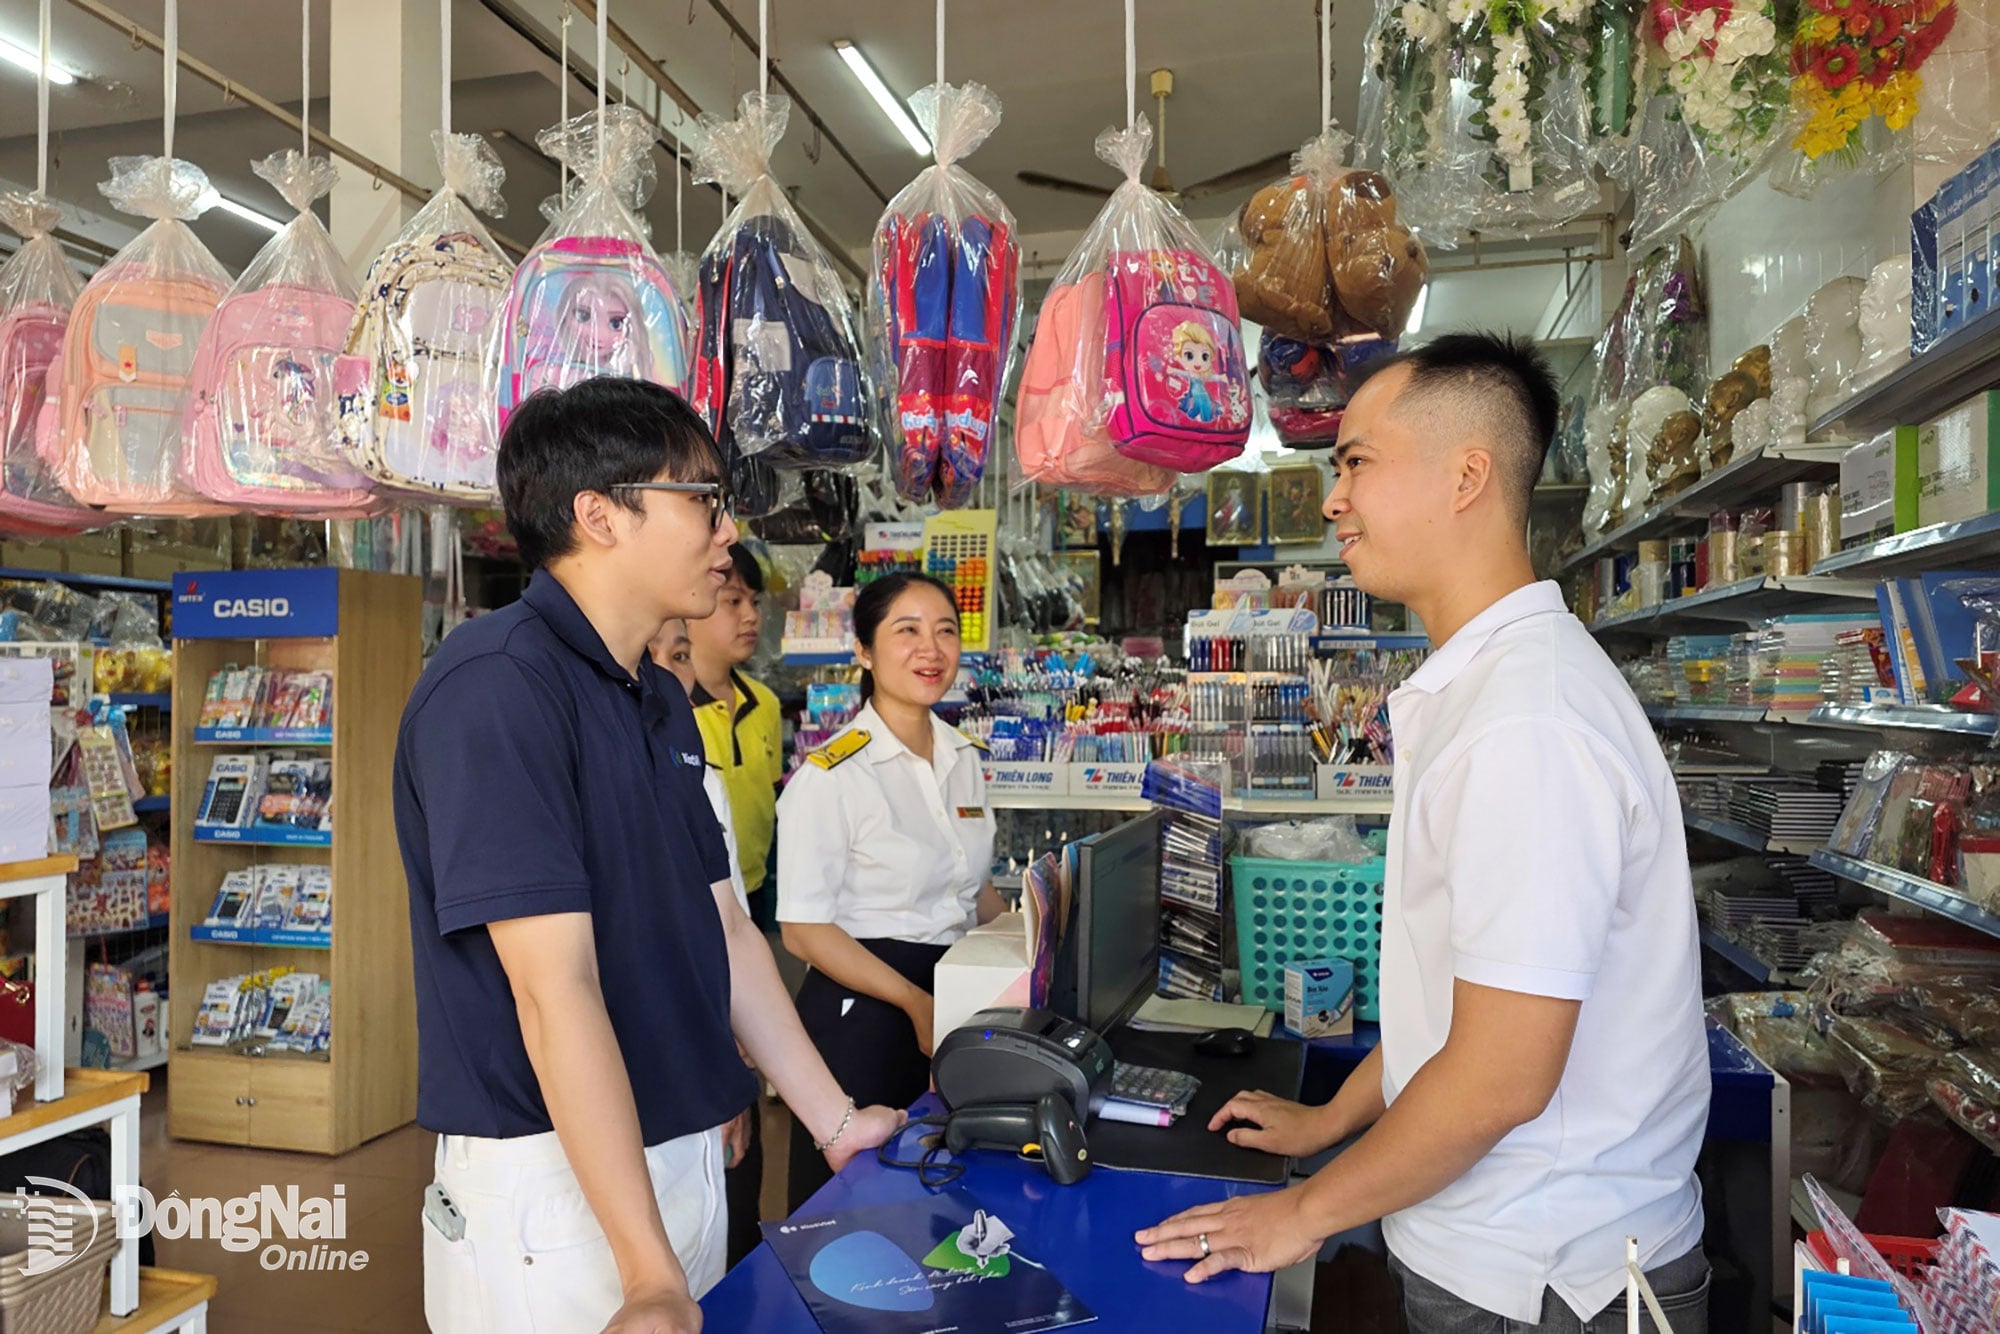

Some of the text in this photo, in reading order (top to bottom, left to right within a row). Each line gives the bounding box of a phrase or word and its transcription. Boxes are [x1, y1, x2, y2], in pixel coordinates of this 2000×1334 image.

[213, 598, 289, 618] CASIO
[215, 730, 241, 739] CASIO
[216, 763, 247, 773] CASIO
[996, 769, 1053, 783] THIÊN LONG
[1106, 770, 1137, 783] THIÊN
[1359, 774, 1392, 787] THIÊN
[214, 829, 240, 839] CASIO
